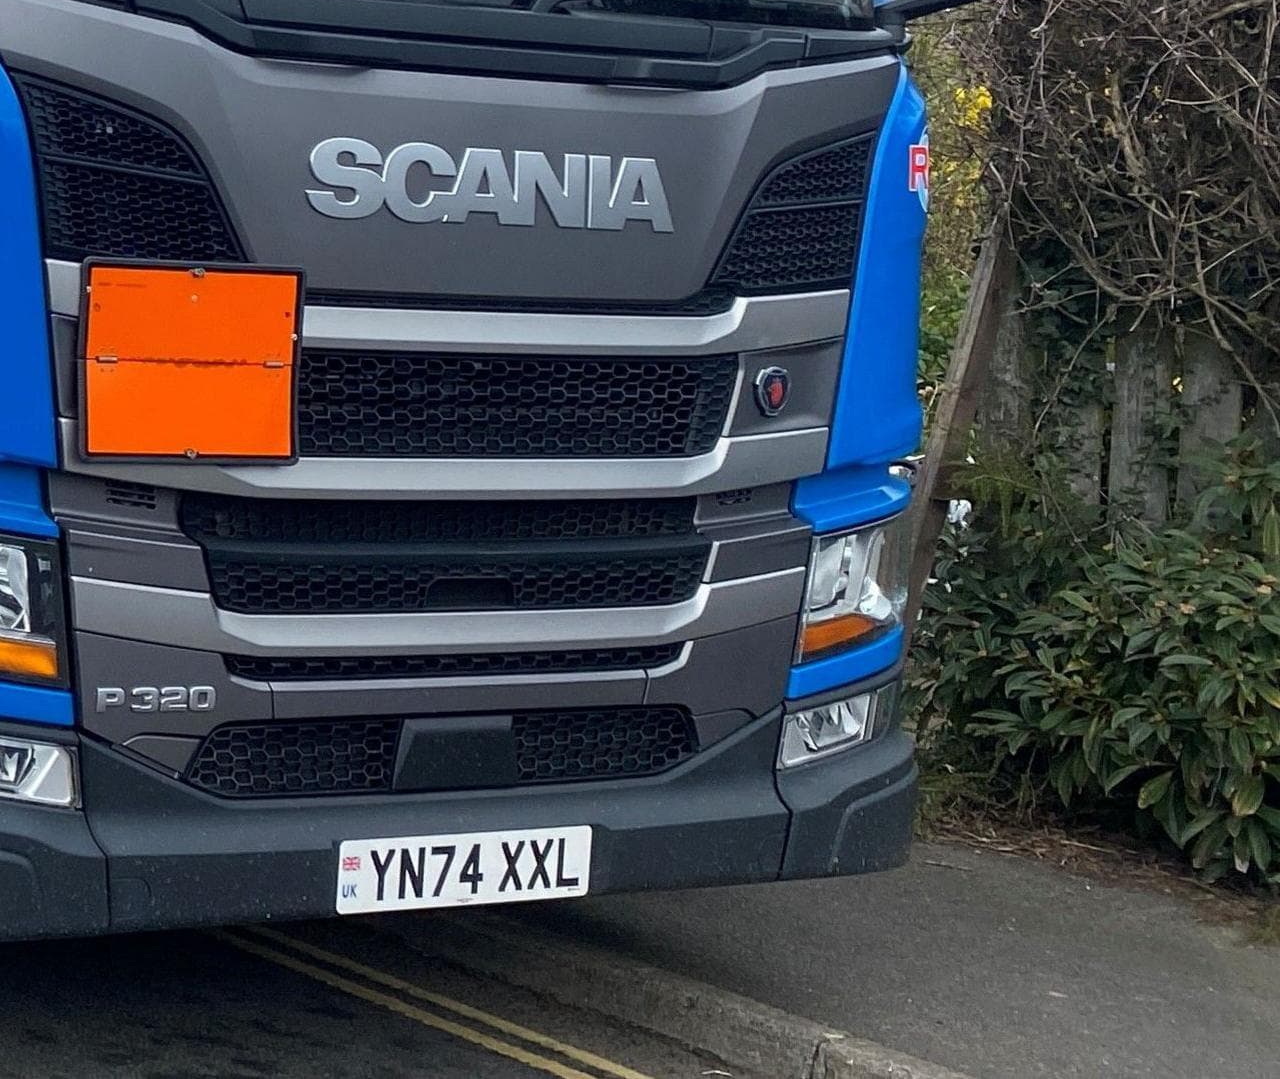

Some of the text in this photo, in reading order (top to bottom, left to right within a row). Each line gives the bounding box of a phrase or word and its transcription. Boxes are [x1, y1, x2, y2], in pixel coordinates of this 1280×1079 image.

[304, 136, 675, 233] SCANIA
[341, 883, 358, 899] UK
[370, 838, 580, 901] YN74 XXL
